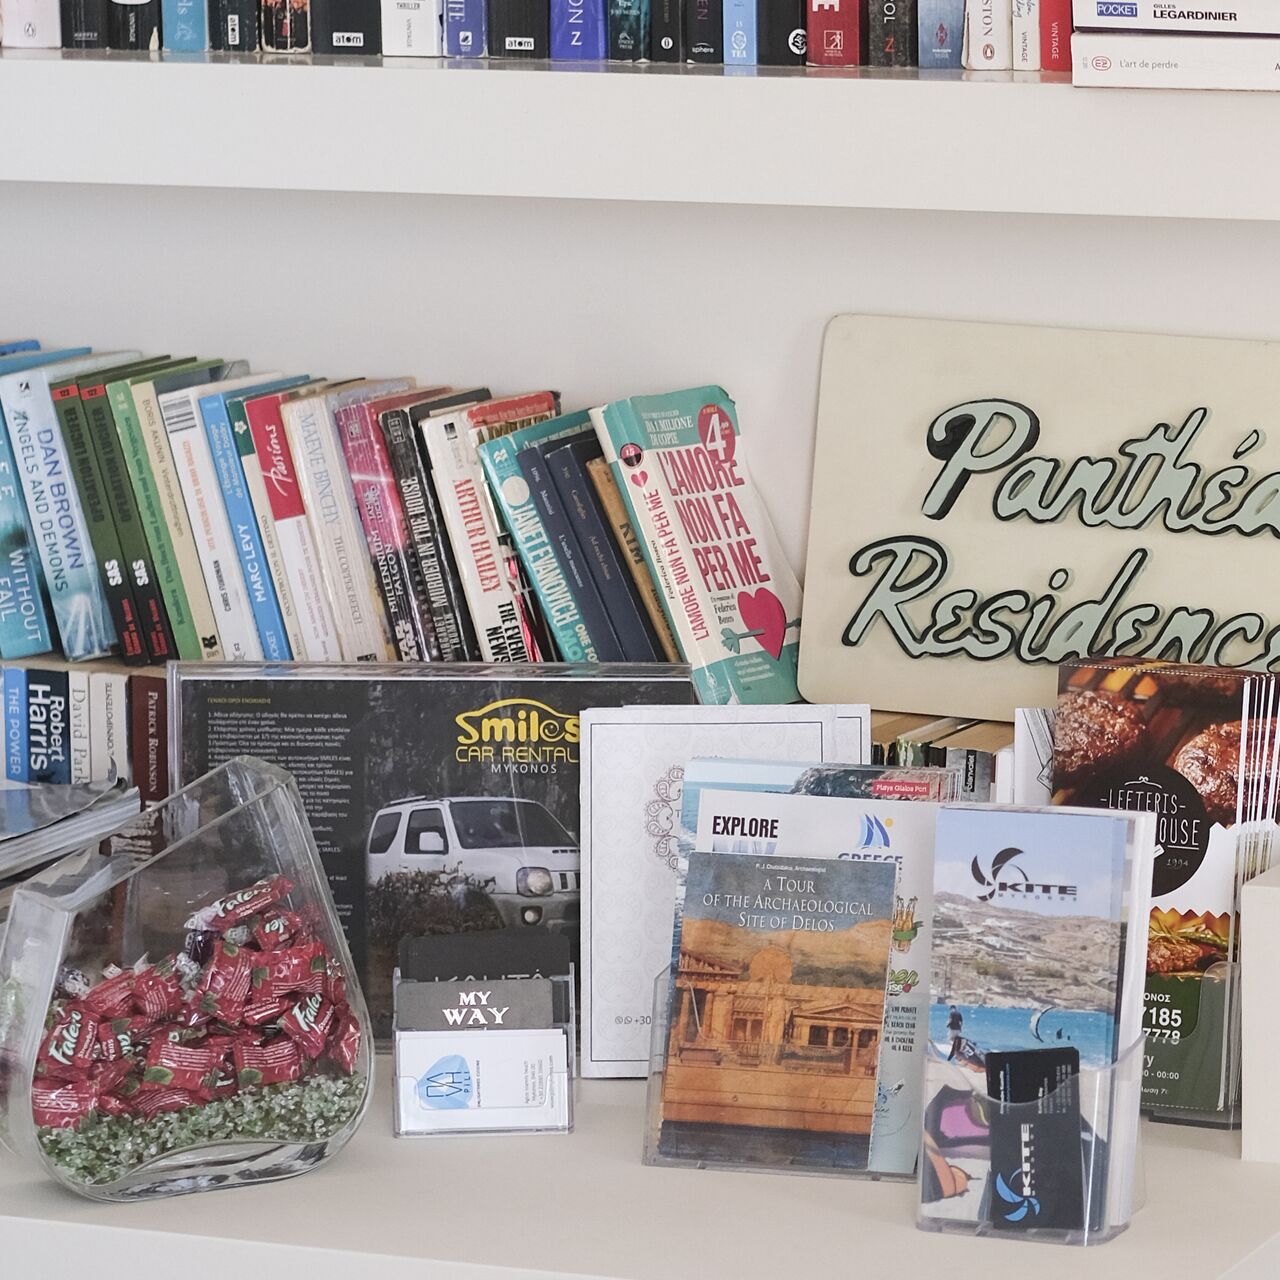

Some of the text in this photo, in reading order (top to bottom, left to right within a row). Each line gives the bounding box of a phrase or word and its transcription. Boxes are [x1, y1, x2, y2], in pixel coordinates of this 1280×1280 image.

[1097, 3, 1137, 15] POCKET
[1153, 10, 1237, 21] LEGARDINIER
[656, 445, 745, 497] L'AMORE
[12, 409, 68, 593] ANGELS AND DEMONS
[38, 429, 84, 569] DAN BROWN
[674, 492, 751, 545] NON FA
[452, 479, 502, 593] ARTHUR HAILEY
[105, 560, 122, 586] SAS
[133, 560, 148, 586] SAS
[237, 524, 267, 602] MARC LEVY
[691, 538, 771, 593] PER ME
[8, 550, 42, 642] WITHOUT
[9, 688, 21, 775] THE POWER
[29, 684, 50, 770] Harris
[50, 695, 65, 762] Robert
[456, 746, 579, 762] CAR RENTAL
[491, 764, 557, 773] MYKONOS
[712, 815, 779, 838] EXPLORE
[1159, 817, 1200, 845] OUSE
[215, 885, 272, 917] Falero
[703, 894, 721, 905] OF
[725, 894, 750, 907] THE
[998, 882, 1077, 895] KITE
[770, 916, 786, 928] OF
[459, 991, 492, 1006] MY
[442, 1007, 509, 1025] WAY
[48, 1010, 83, 1065] Falero
[1157, 1071, 1179, 1079] 00:00
[1021, 1124, 1031, 1196] KITE
